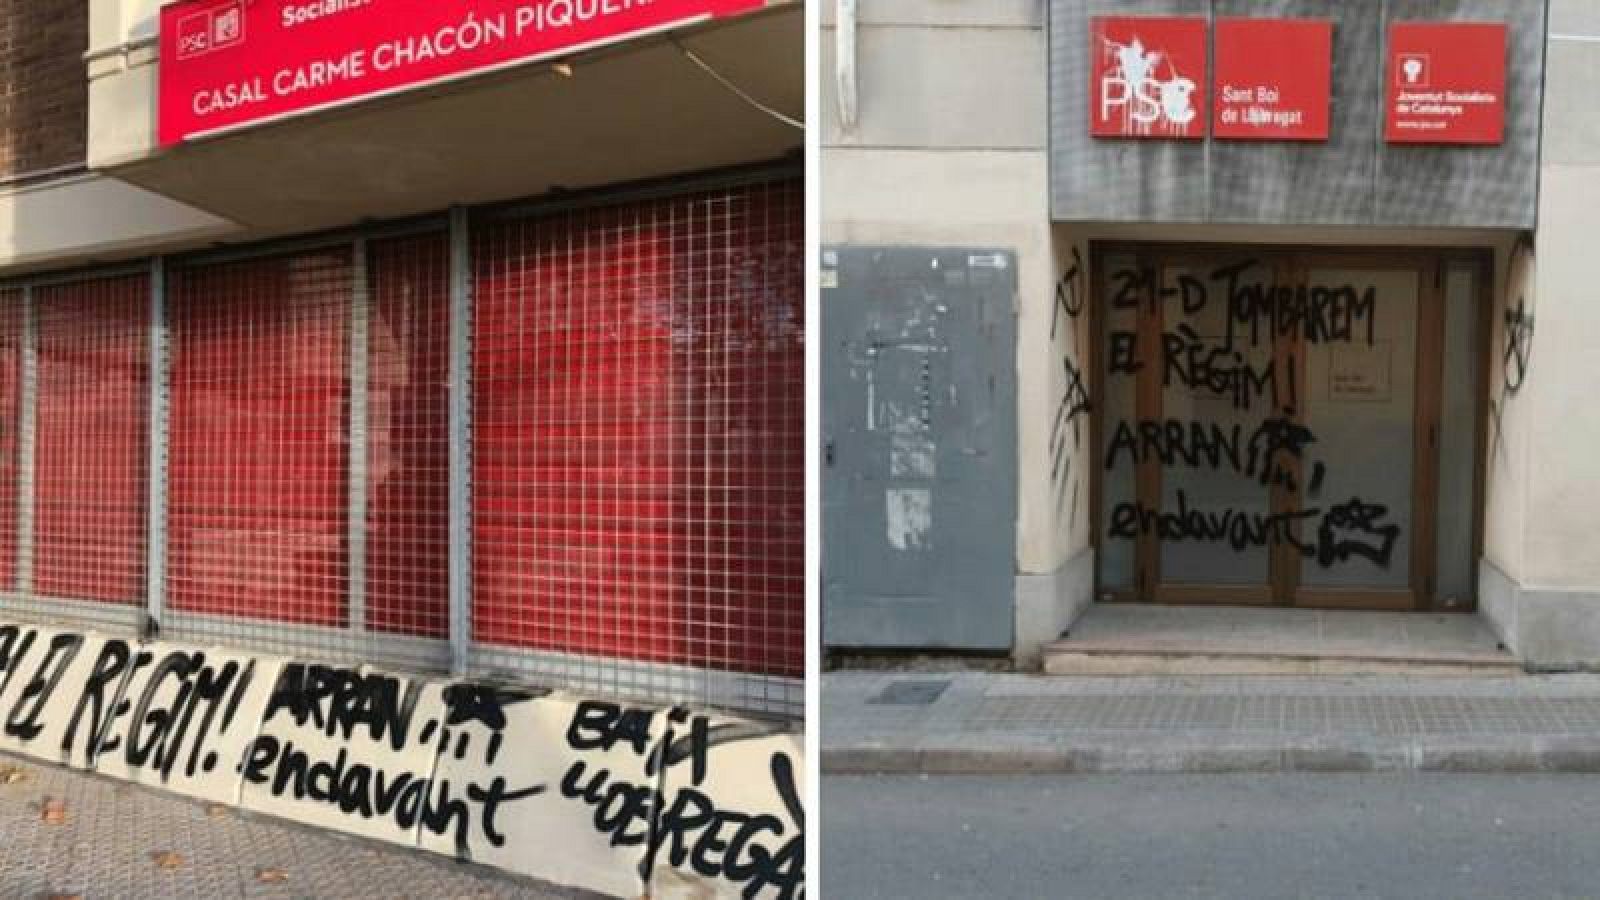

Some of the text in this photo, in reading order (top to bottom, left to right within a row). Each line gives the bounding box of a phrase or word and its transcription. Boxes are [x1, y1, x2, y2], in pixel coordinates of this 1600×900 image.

[192, 76, 269, 115] CASAL
[273, 49, 366, 95] CARME
[371, 12, 507, 71] CHACÓN
[1222, 85, 1280, 103] Sant Boi
[1221, 108, 1238, 124] de
[1211, 257, 1377, 351] TOMBAREM
[1108, 330, 1145, 375] EL
[1104, 418, 1242, 472] ARRAN
[1107, 489, 1321, 557] endavant
[263, 662, 424, 750] ARRAN
[237, 734, 547, 863] endavant
